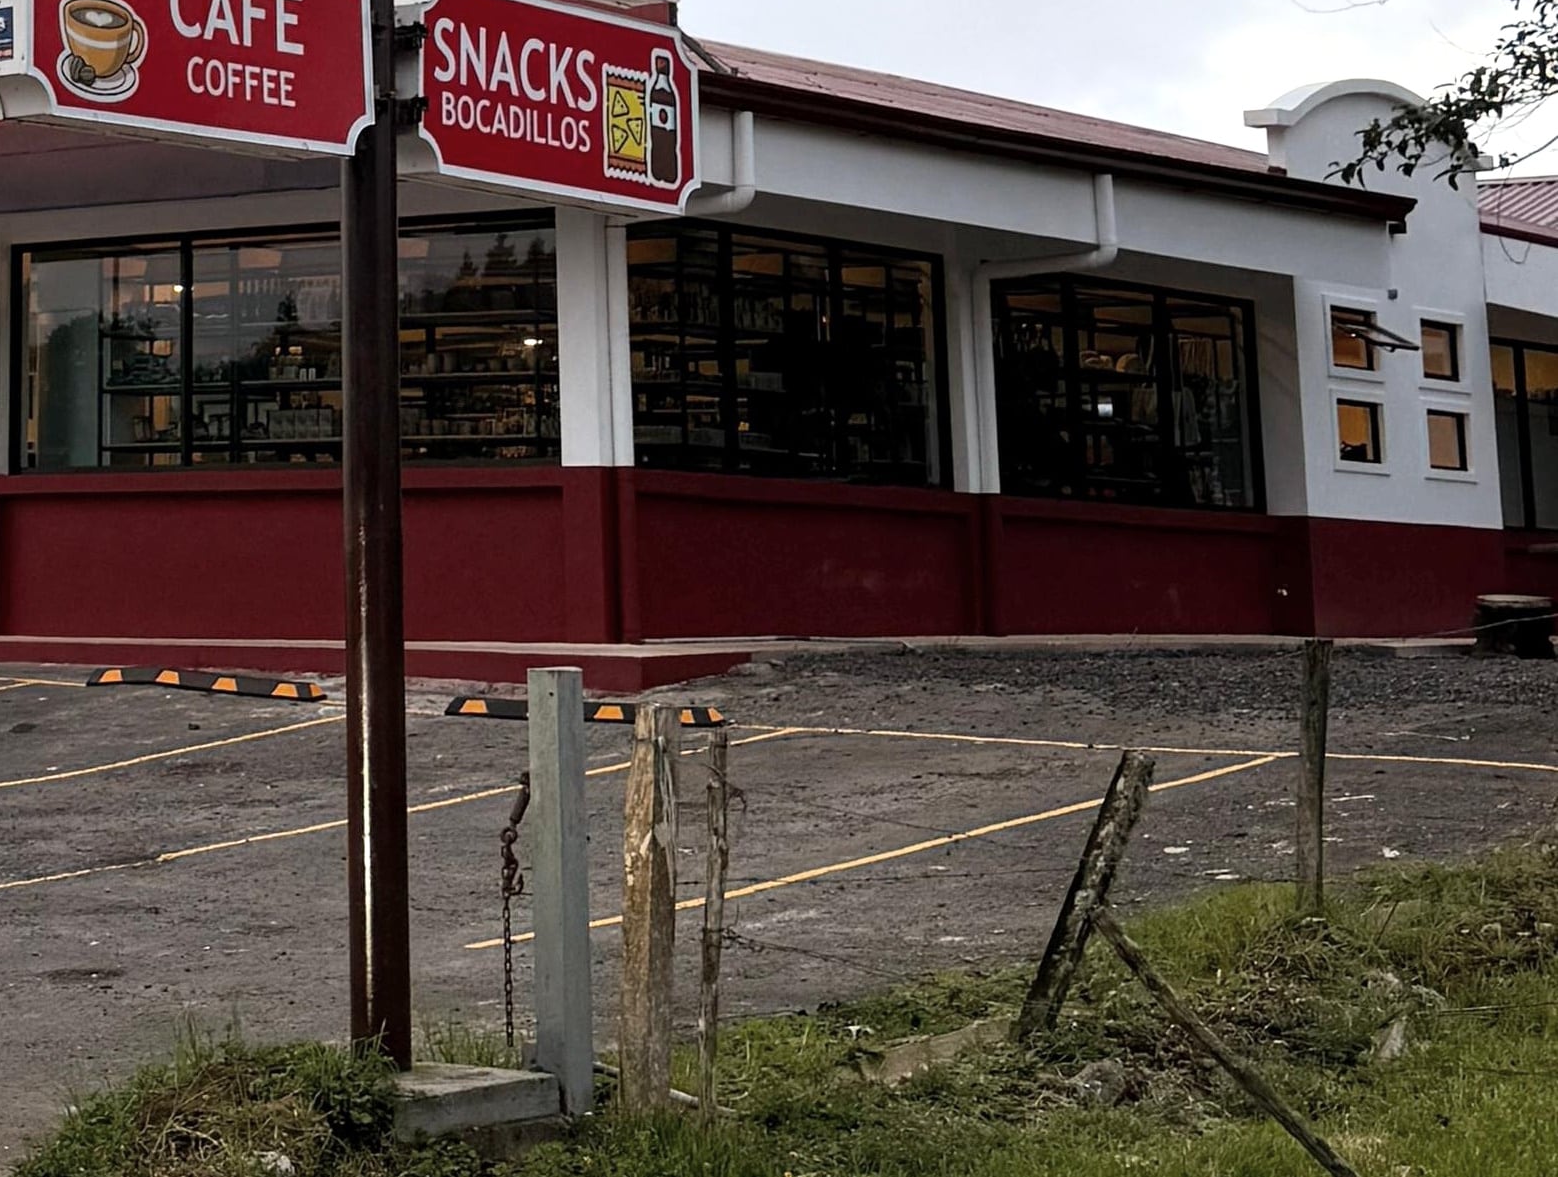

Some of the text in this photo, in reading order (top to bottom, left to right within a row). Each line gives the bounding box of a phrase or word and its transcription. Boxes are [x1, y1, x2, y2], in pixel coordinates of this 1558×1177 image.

[187, 56, 296, 107] COFFEE
[433, 17, 598, 112] SNACKS
[441, 91, 591, 153] BOCADILLOS
